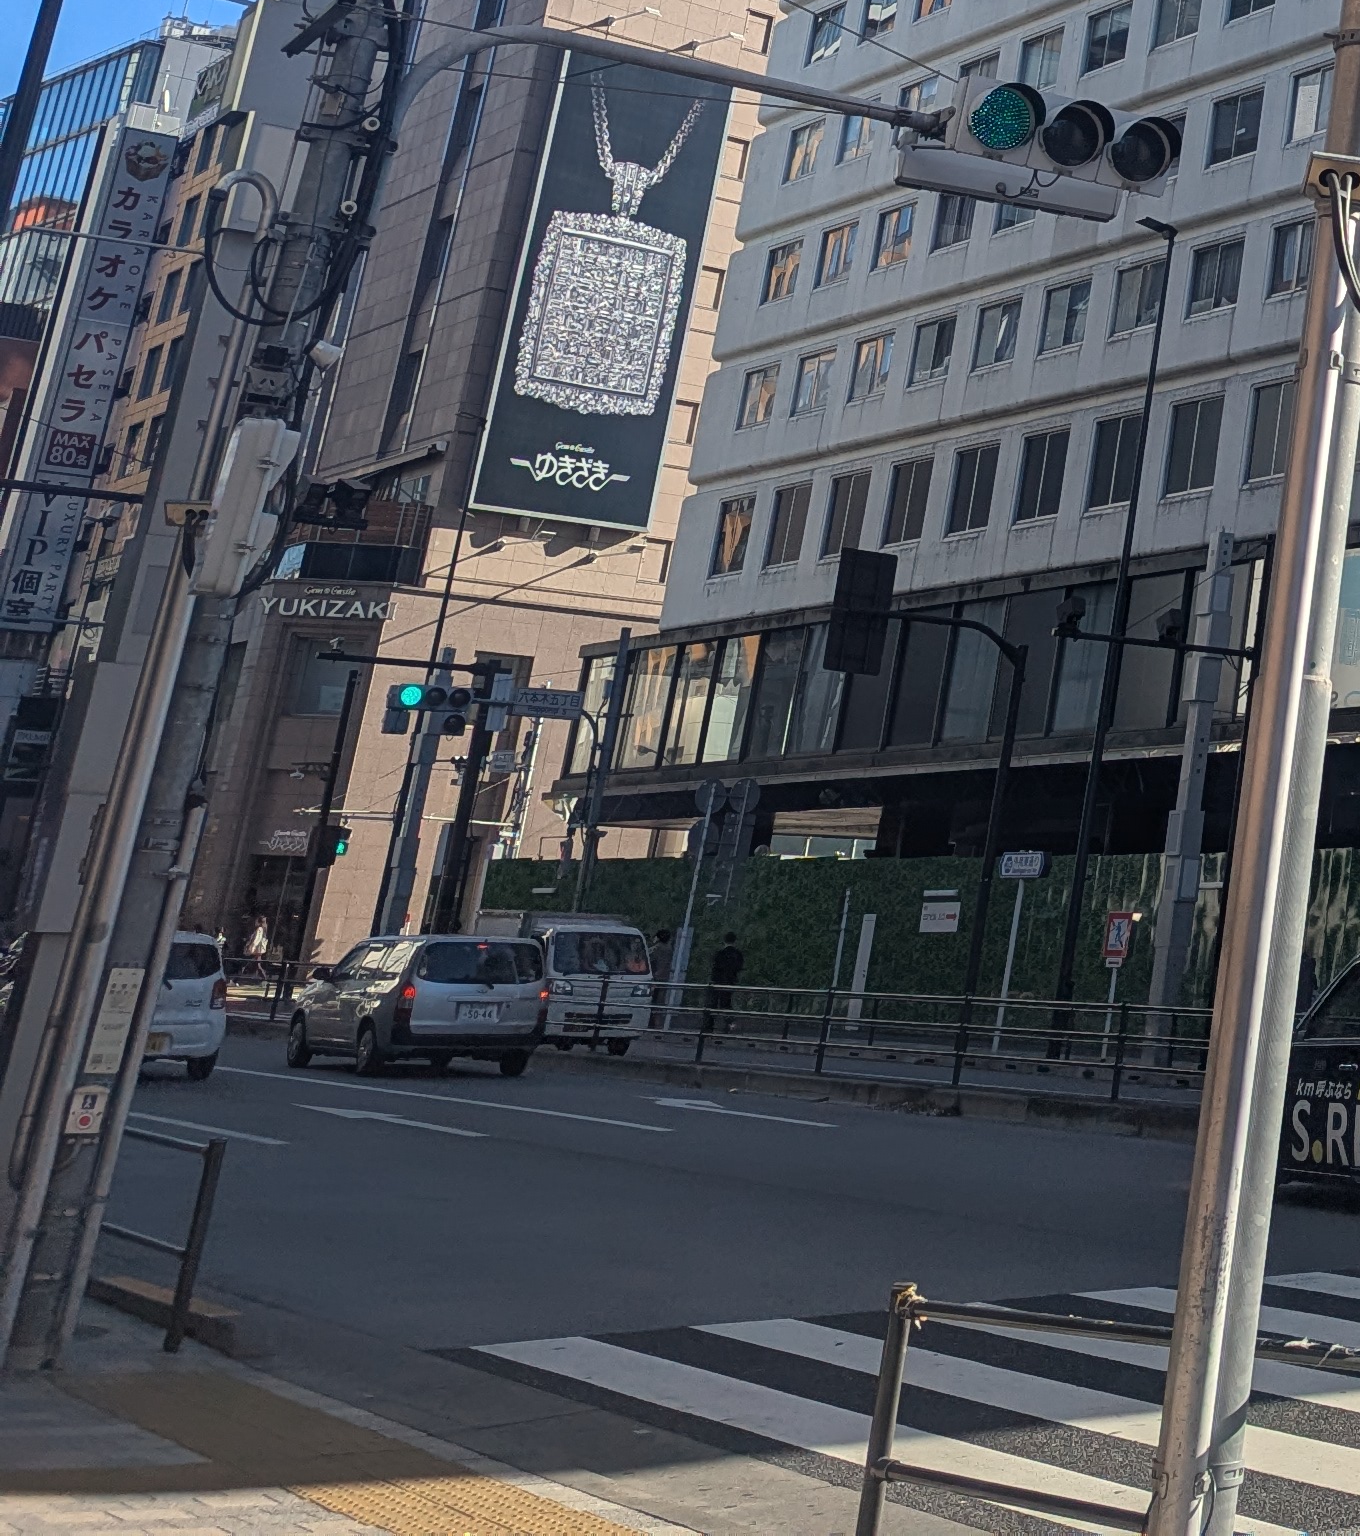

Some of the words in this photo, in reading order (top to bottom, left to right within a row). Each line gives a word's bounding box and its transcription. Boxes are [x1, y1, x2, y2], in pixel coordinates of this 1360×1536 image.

[119, 195, 159, 310] KARAOKE
[89, 337, 122, 422] PASELA
[54, 432, 90, 449] MAX
[50, 447, 88, 466] 80名
[524, 452, 620, 491] ゆきざき
[518, 691, 581, 708] 六本木五丁目
